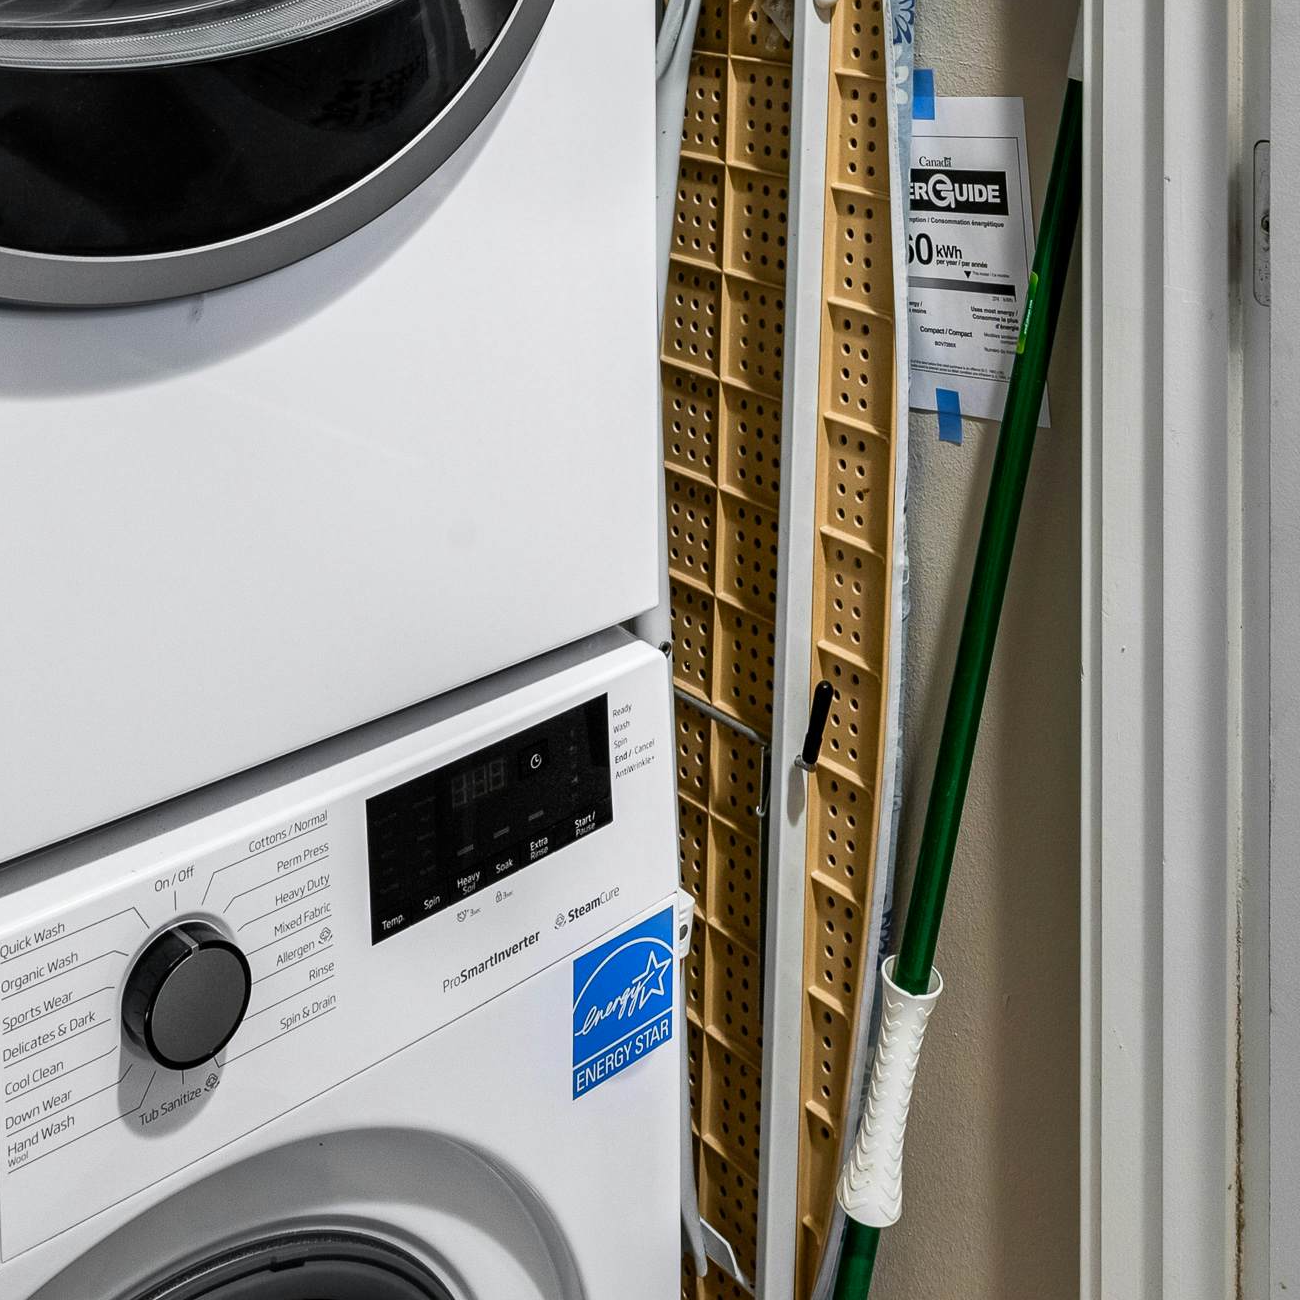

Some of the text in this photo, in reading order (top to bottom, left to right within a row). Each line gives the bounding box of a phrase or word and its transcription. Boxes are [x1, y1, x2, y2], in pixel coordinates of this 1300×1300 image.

[919, 156, 951, 167] Canada
[931, 217, 970, 226] Consommation
[936, 245, 962, 259] kWh
[920, 326, 944, 334] Compact
[948, 329, 973, 338] Compact
[613, 702, 632, 718] Ready
[613, 720, 630, 734] Wash
[614, 736, 628, 749] Spin
[614, 751, 628, 764] End
[634, 739, 655, 755] Cancel
[248, 831, 287, 853] Cottons
[294, 810, 328, 833] Normal
[575, 813, 591, 828] Start
[575, 821, 595, 837] Pause
[530, 836, 548, 851] Extra
[530, 846, 549, 860] Rinse
[277, 841, 329, 873] Perm Press
[495, 858, 513, 874] Soak
[154, 878, 171, 892] On
[178, 865, 195, 883] Off
[275, 873, 330, 907] Heavy Duty
[457, 870, 480, 888] Heavy
[462, 884, 476, 895] Soil
[424, 895, 440, 910] Spin
[568, 886, 620, 923] SteamCure
[274, 901, 332, 937] Mixed Fabric
[382, 913, 404, 931] Temp.
[0, 922, 66, 959] Quick Wash
[276, 939, 315, 967] Allergen
[0, 952, 79, 994] Organic Wash
[308, 960, 335, 981] Rinse
[443, 930, 540, 993] ProSmartInverter
[2, 989, 74, 1031] Sports Wear
[280, 993, 337, 1032] Spin & Drain
[3, 1011, 96, 1062] Delicates & Dark
[576, 1018, 669, 1092] ENERGY STAR
[5, 1059, 65, 1096] Cool Clean
[5, 1089, 73, 1130] Down Wear
[139, 1088, 202, 1126] Tub Sanitize
[7, 1115, 76, 1157] Hand Wash
[8, 1151, 29, 1168] Wool
